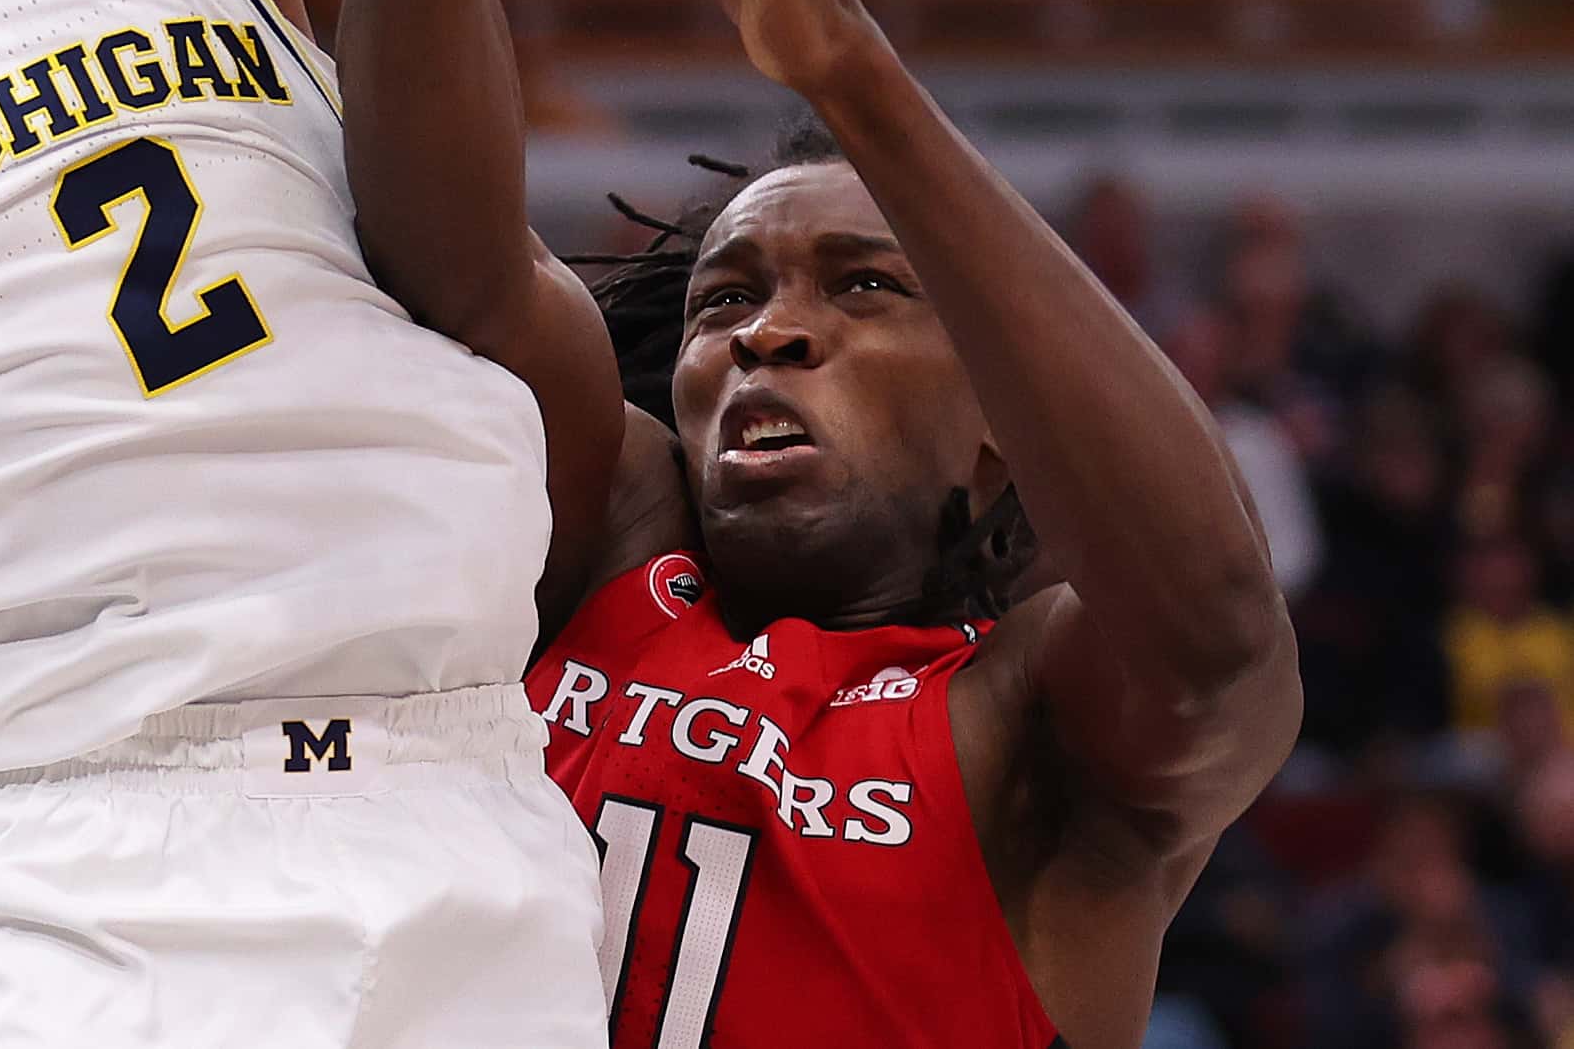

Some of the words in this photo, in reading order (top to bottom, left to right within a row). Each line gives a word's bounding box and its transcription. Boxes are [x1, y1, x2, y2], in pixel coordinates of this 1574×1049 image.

[48, 134, 274, 401] 2
[281, 718, 354, 774] M
[541, 657, 916, 847] RTGERS
[594, 793, 762, 1049] 11
